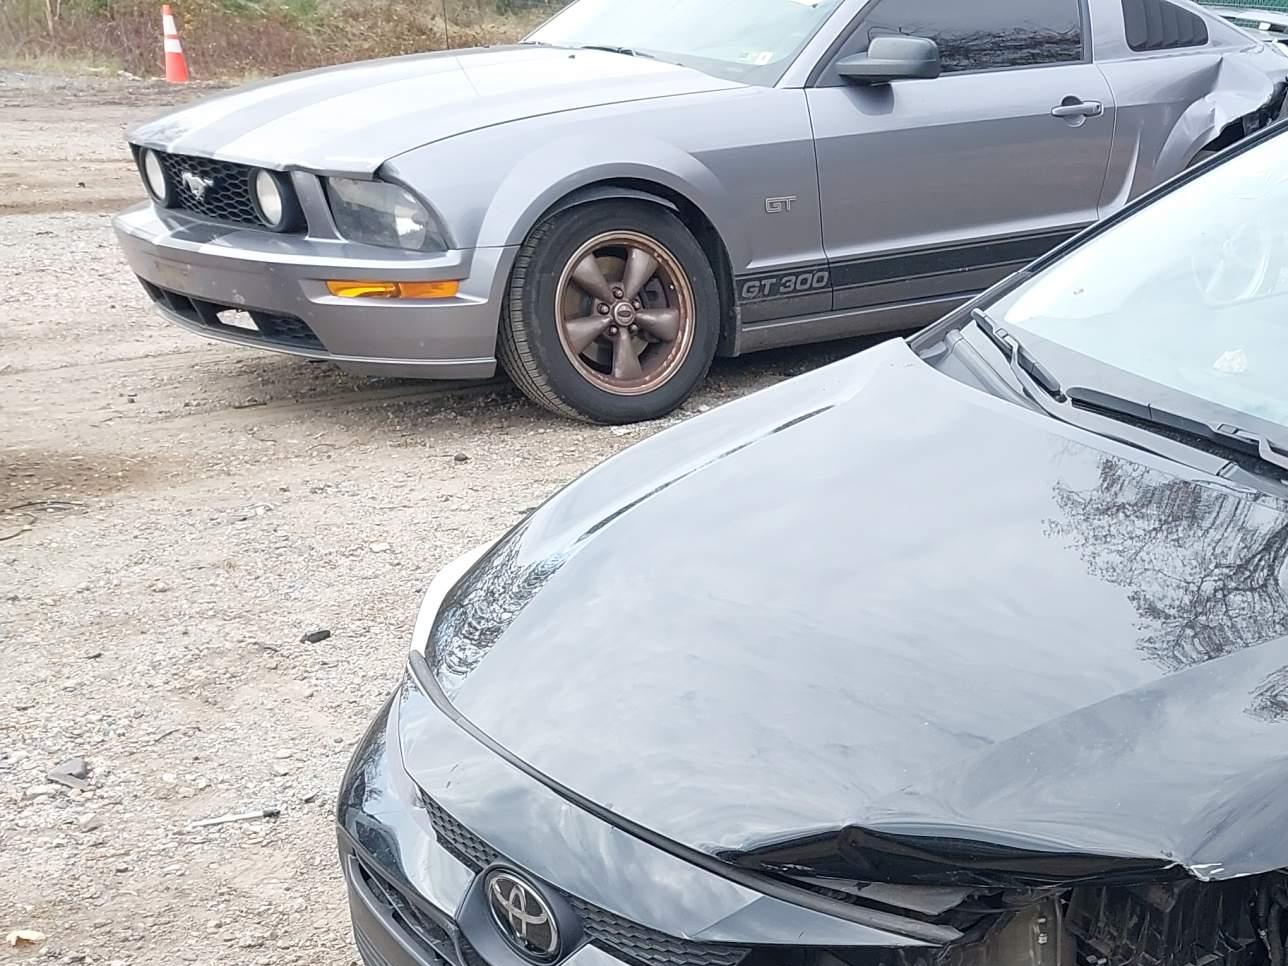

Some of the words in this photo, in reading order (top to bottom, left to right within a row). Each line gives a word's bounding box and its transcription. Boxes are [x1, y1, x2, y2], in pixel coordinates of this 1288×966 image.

[765, 195, 797, 213] GT
[741, 278, 777, 298] GT
[780, 271, 829, 293] 300
